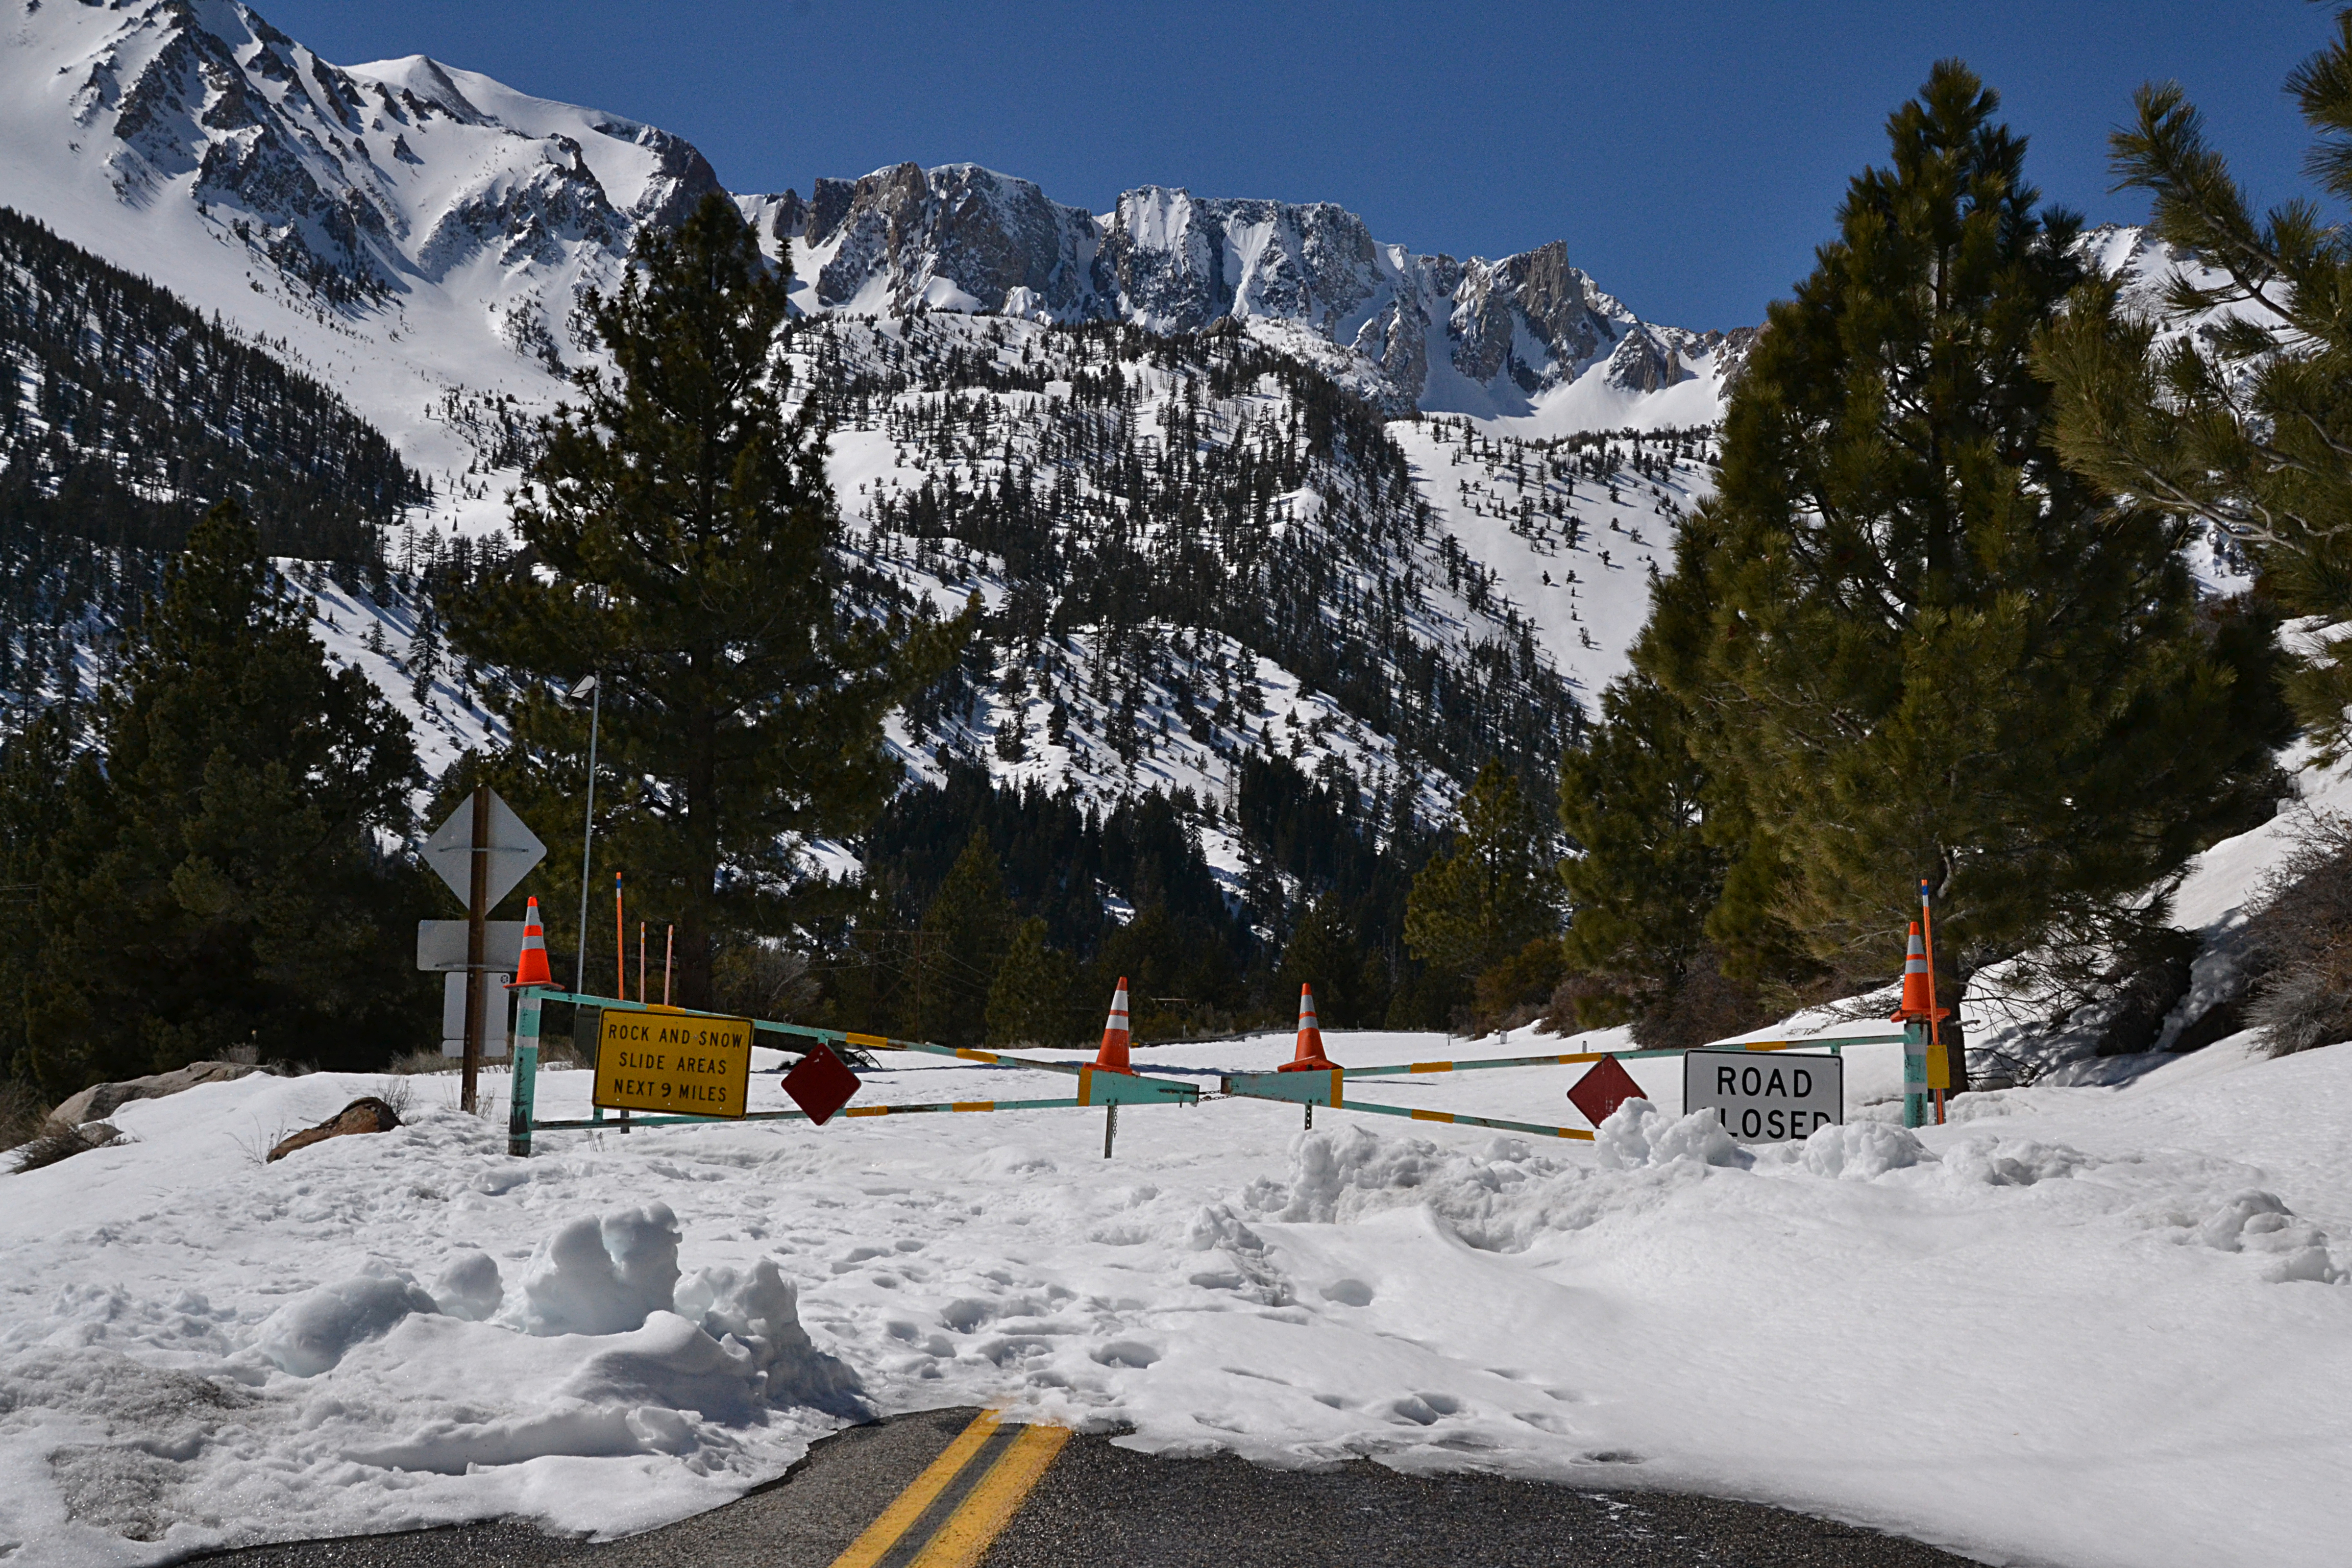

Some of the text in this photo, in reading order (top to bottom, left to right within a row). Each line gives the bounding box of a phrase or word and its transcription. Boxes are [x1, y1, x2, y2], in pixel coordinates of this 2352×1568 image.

[608, 1024, 743, 1048] ROCK AND SNOW
[619, 1051, 726, 1075] SLIDE AREAS
[614, 1079, 726, 1102] NEXT 9 MILES
[1717, 1066, 1812, 1098] ROAD
[1701, 1107, 1831, 1139] LOSED
